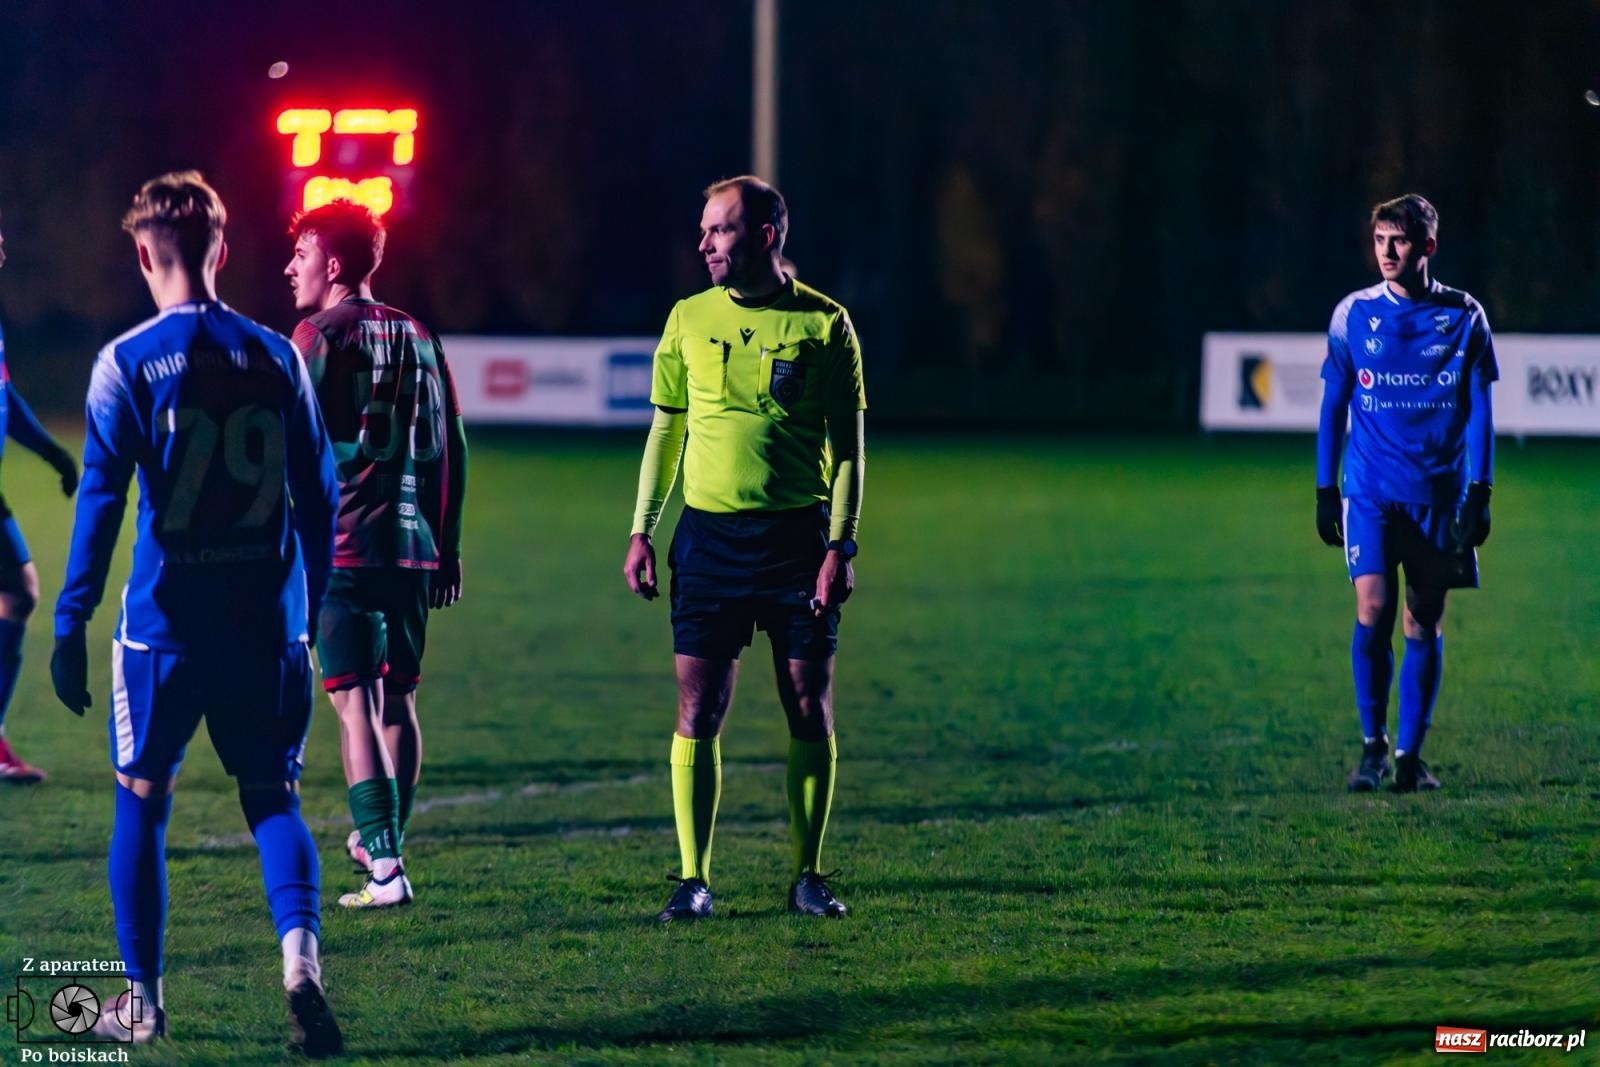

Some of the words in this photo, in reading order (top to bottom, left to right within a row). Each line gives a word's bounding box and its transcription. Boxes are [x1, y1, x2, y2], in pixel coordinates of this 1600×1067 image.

[142, 351, 189, 383] UNIA
[1377, 371, 1431, 386] Marco
[157, 404, 283, 532] 79
